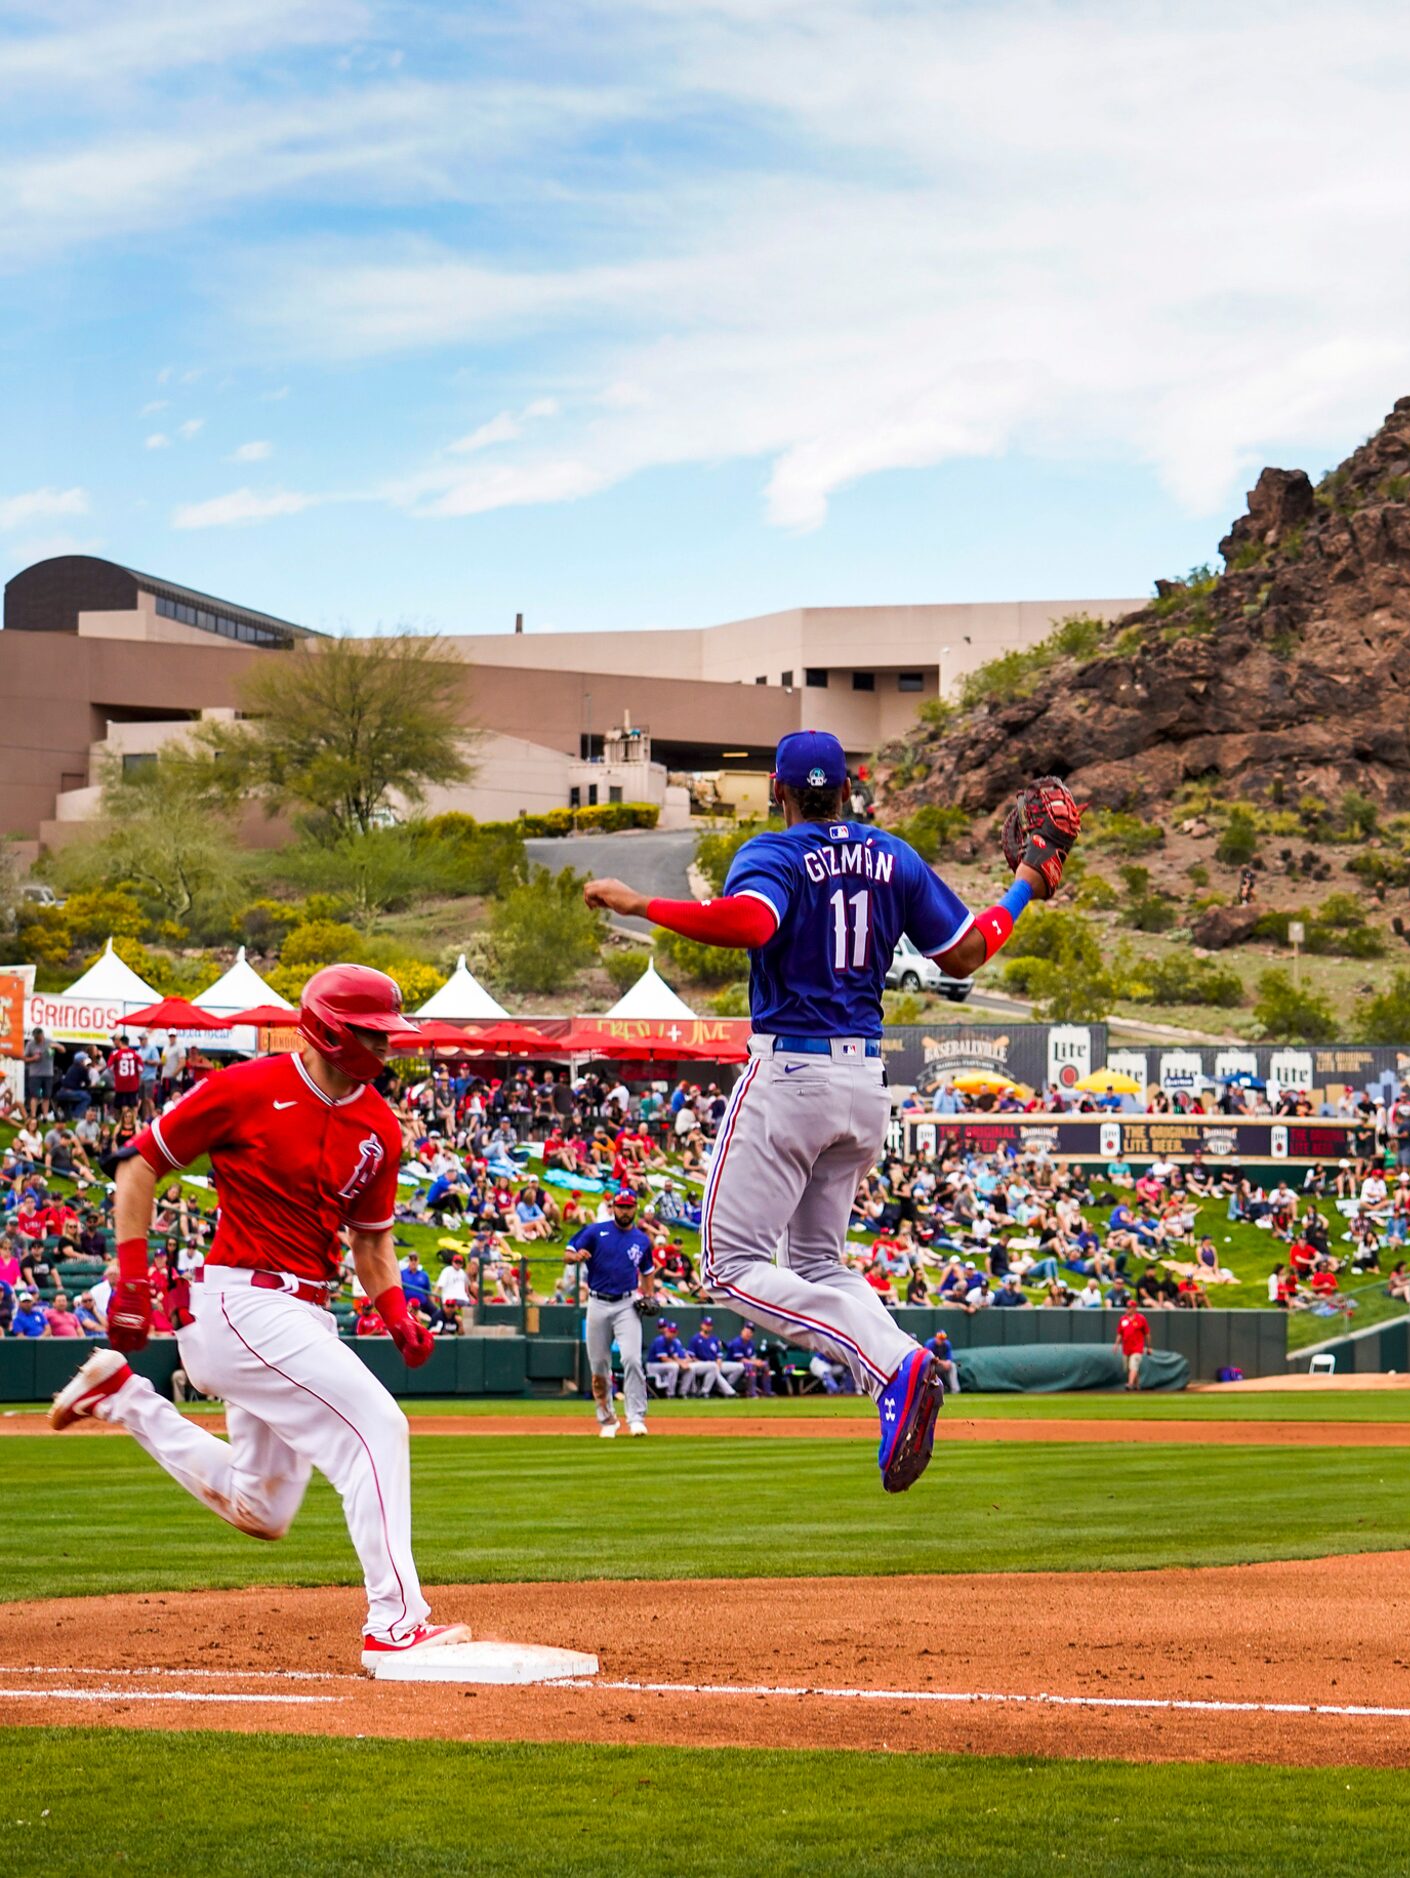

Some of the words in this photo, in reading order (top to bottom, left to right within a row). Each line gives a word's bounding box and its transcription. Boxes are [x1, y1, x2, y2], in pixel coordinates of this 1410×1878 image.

[829, 889, 871, 972] 11
[1054, 1041, 1087, 1062] Lite
[1276, 1067, 1309, 1087] Lite
[1123, 1125, 1146, 1139] THE
